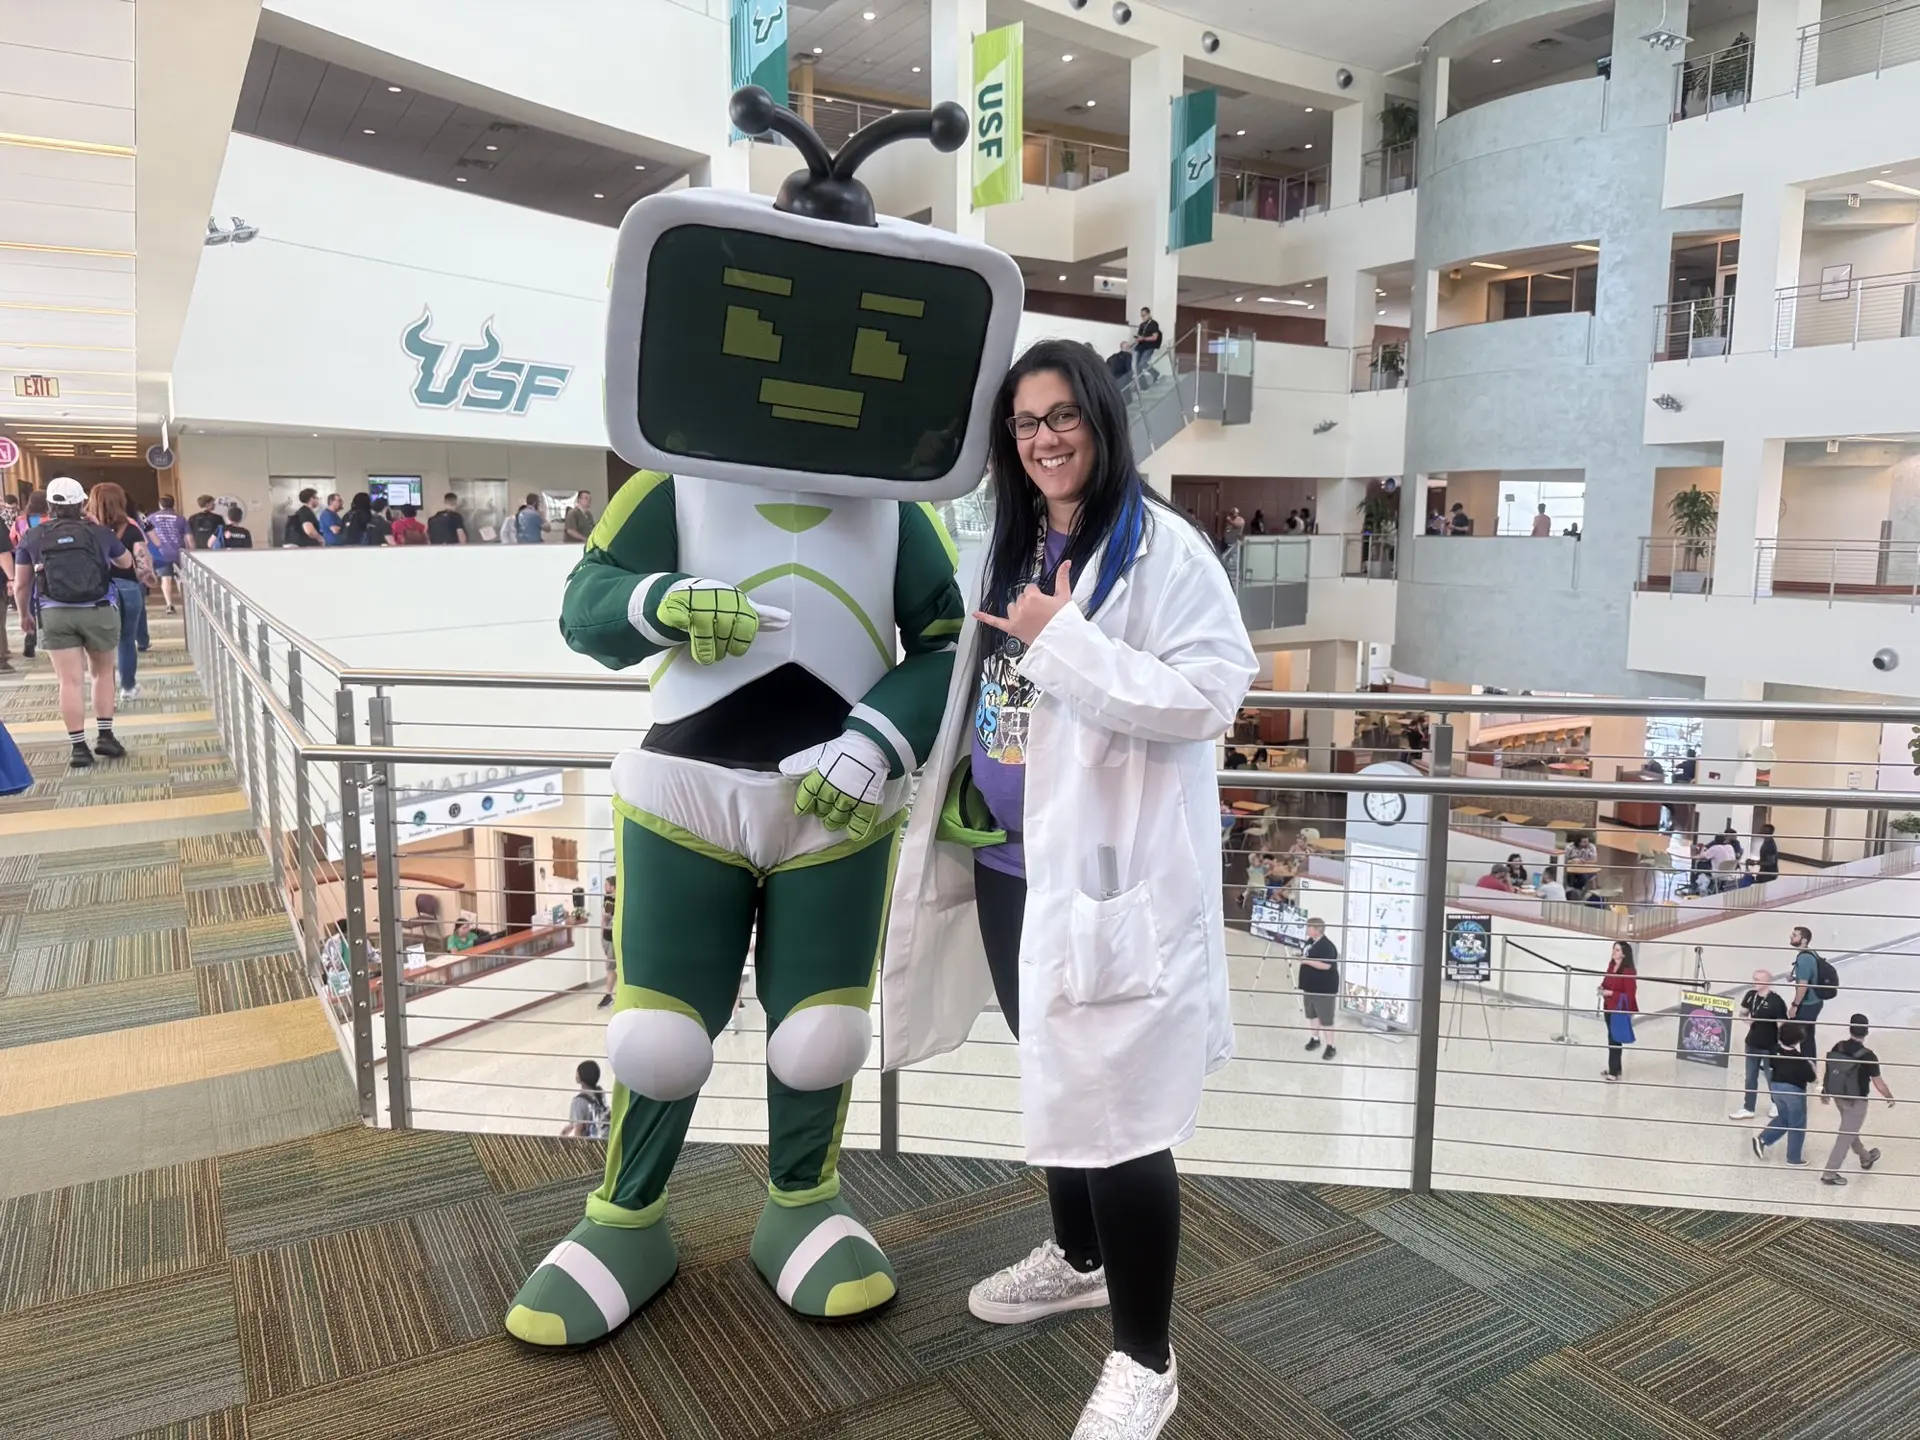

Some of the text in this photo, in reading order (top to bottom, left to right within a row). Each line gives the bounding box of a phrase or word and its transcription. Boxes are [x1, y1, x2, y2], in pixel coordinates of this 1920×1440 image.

[978, 82, 1003, 158] USF
[24, 377, 51, 396] EXIT
[400, 303, 575, 416] USF
